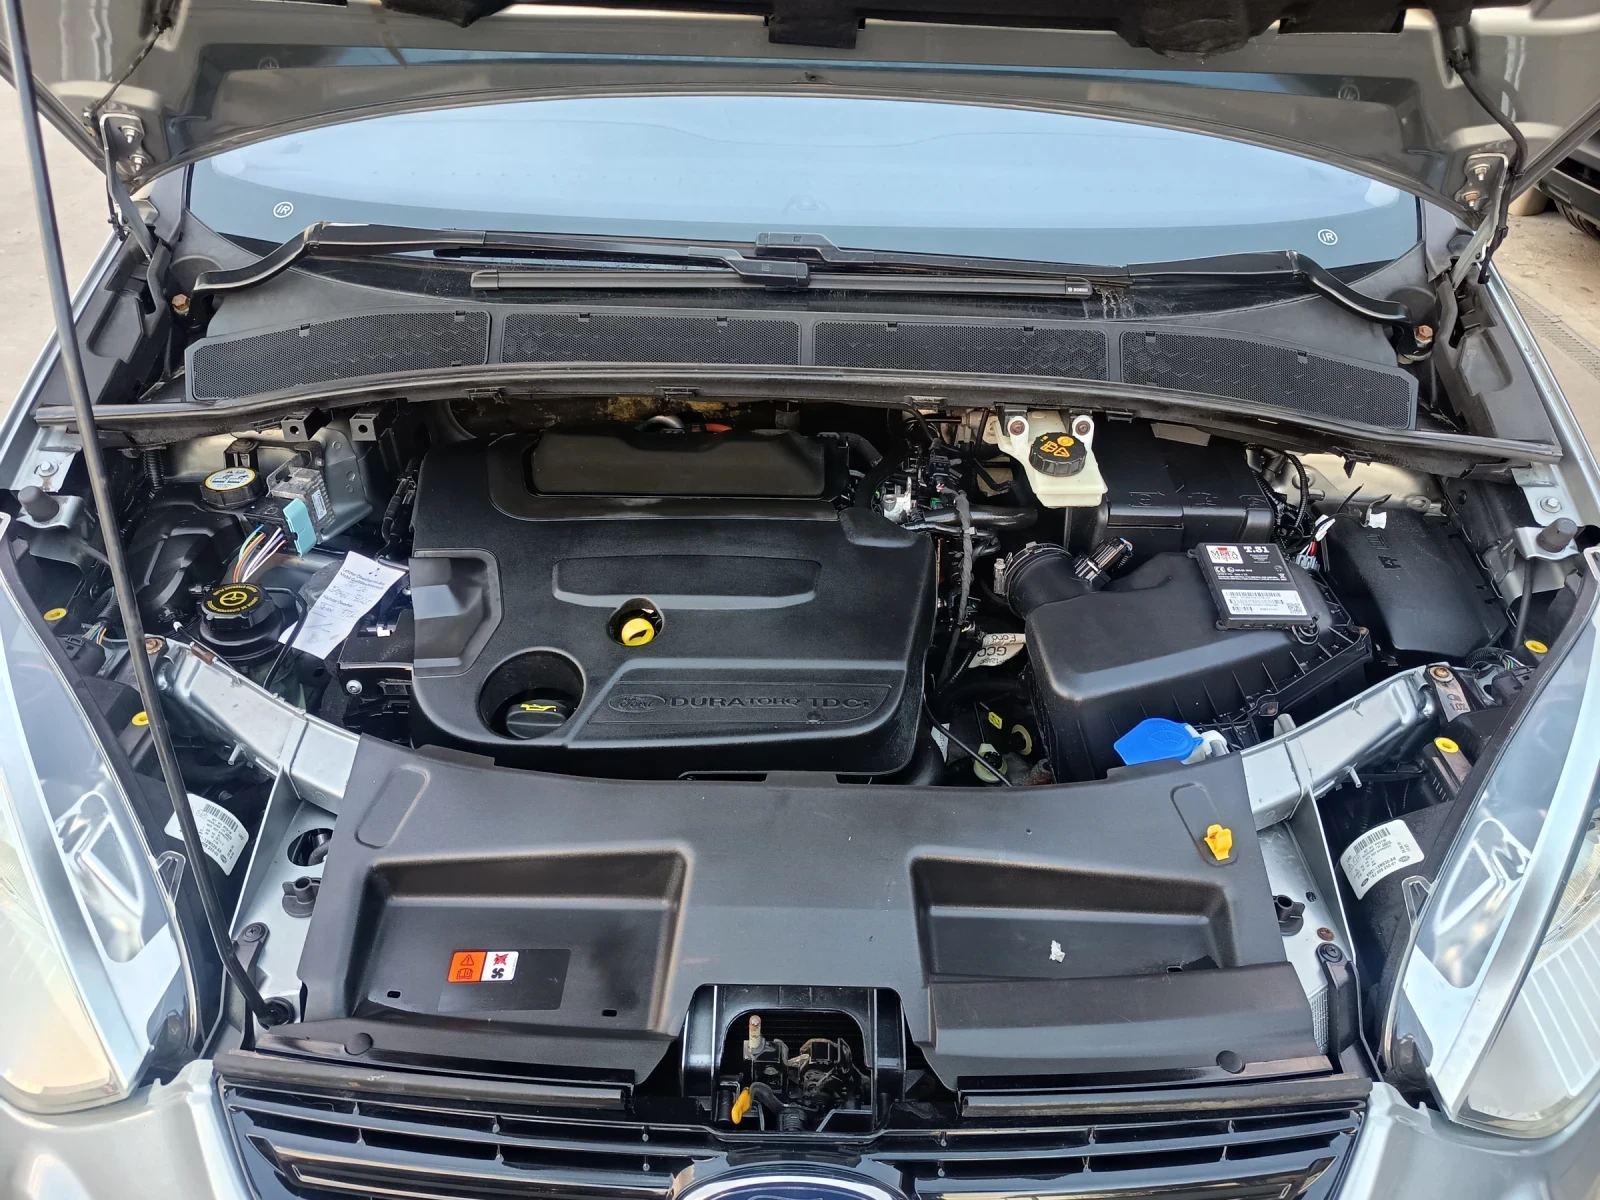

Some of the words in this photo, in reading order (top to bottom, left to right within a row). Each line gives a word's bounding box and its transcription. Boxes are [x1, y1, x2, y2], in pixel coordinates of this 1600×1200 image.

[276, 204, 290, 214] IR
[1322, 232, 1334, 242] IR
[670, 696, 800, 708] DURATORQ
